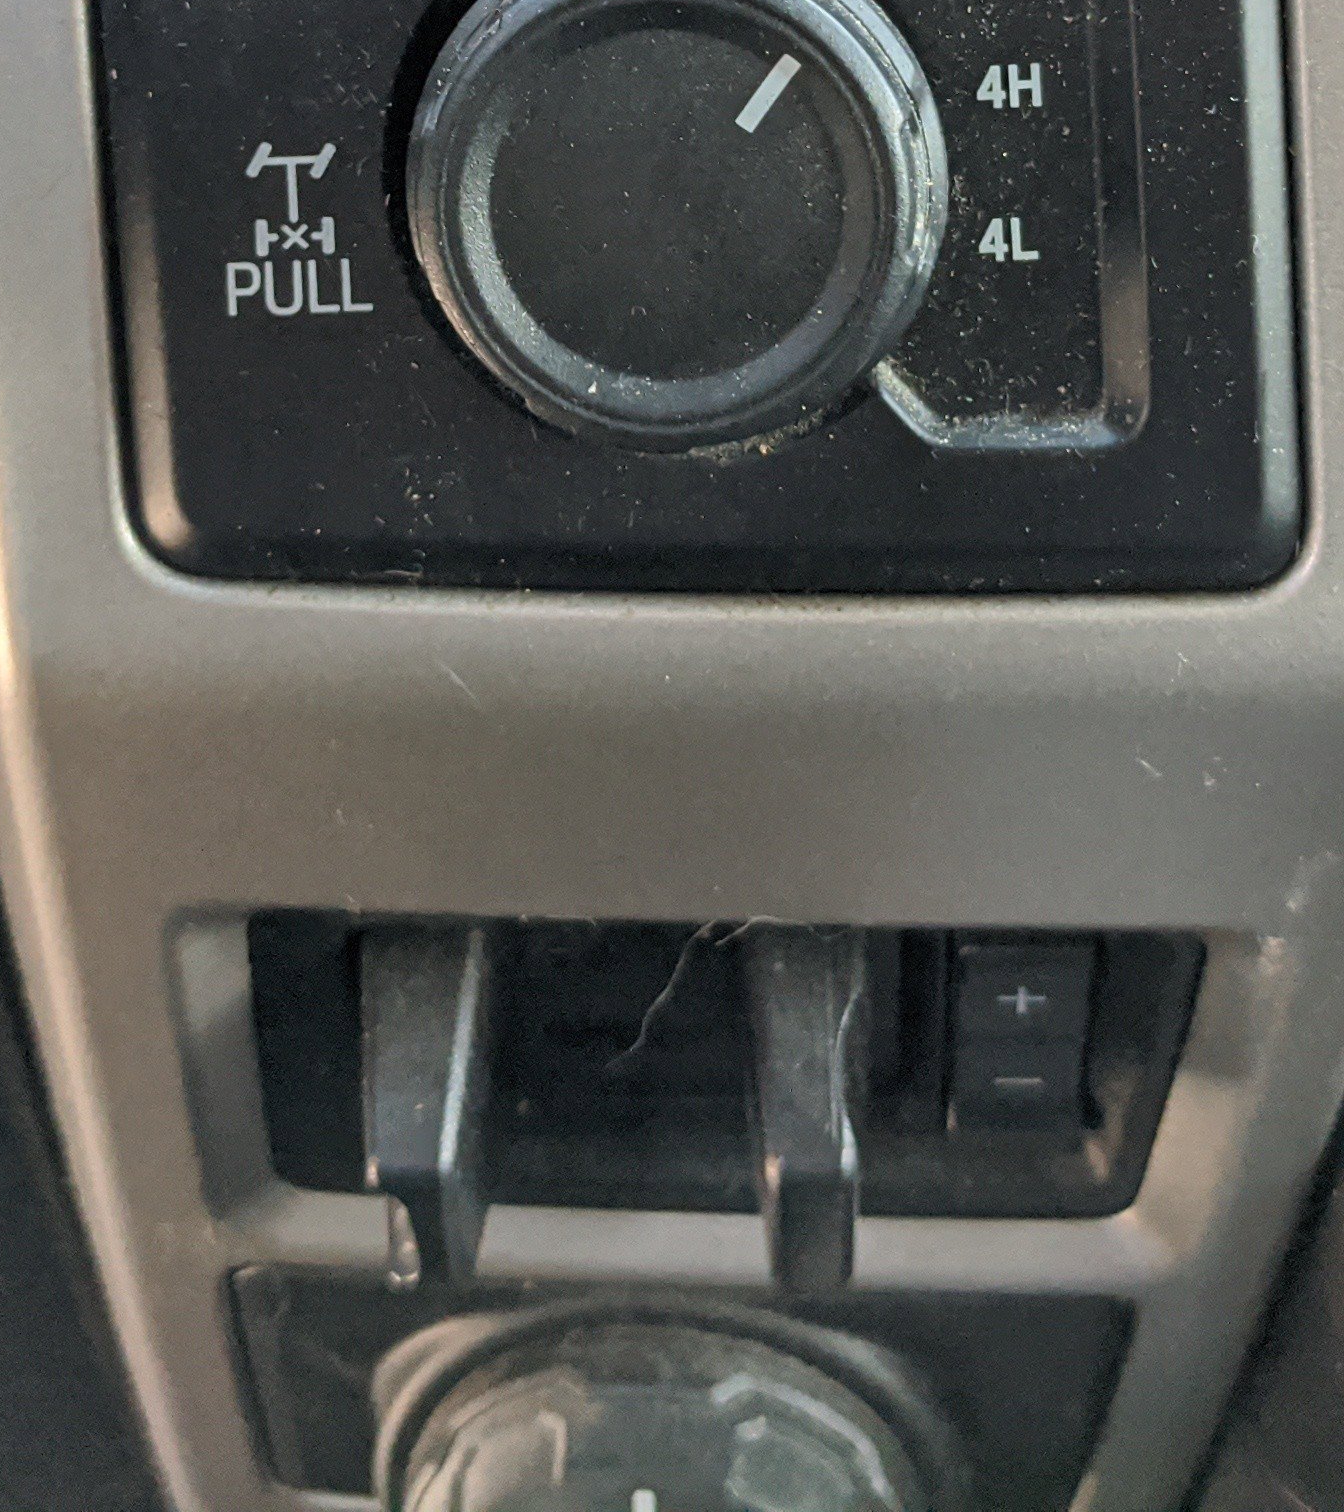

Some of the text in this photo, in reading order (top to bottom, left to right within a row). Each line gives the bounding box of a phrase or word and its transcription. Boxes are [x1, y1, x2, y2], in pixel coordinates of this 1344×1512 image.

[976, 62, 1044, 109] 4H
[978, 216, 1040, 262] 4L
[226, 258, 374, 317] PULL
